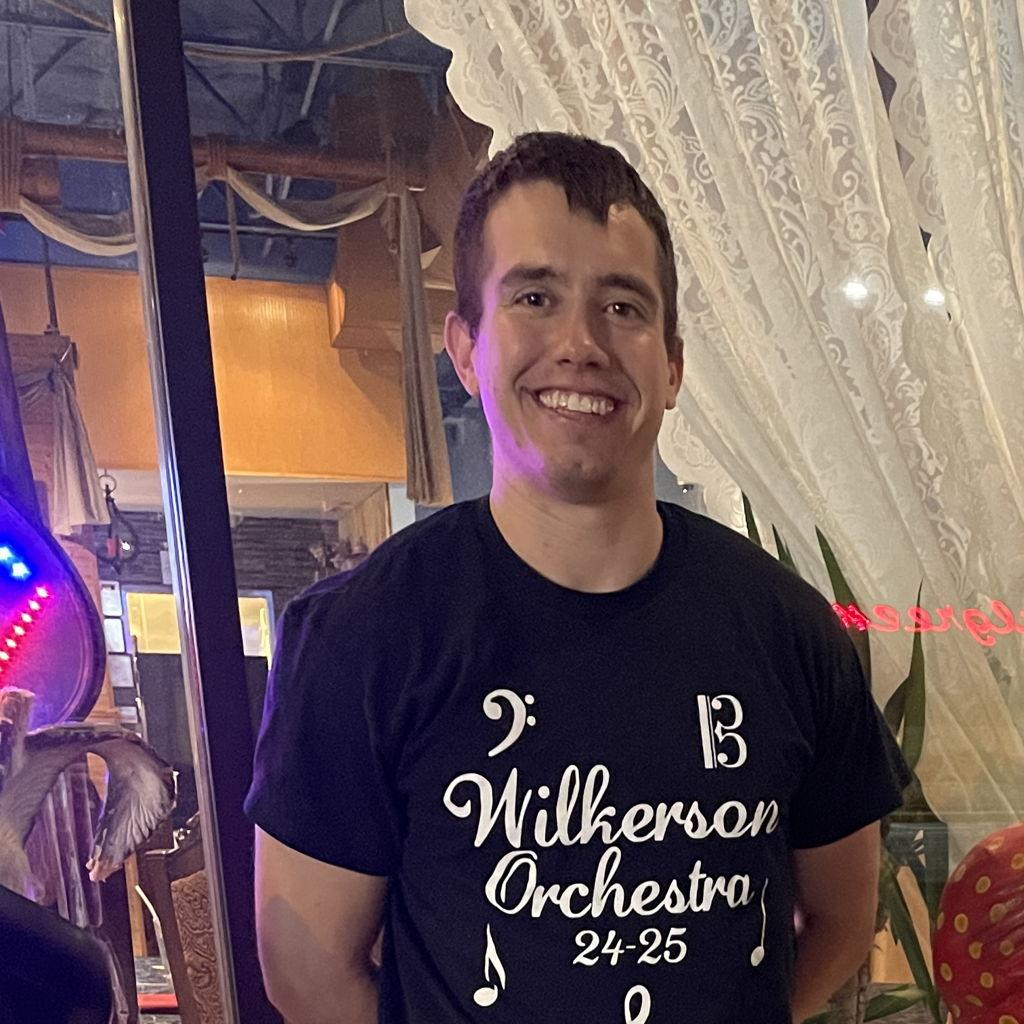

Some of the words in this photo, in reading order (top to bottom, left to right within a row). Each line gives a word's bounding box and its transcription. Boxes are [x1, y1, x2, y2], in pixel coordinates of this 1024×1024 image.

[443, 764, 779, 848] Wilkerson
[485, 846, 755, 918] Orchestra
[573, 927, 687, 965] 24-25
